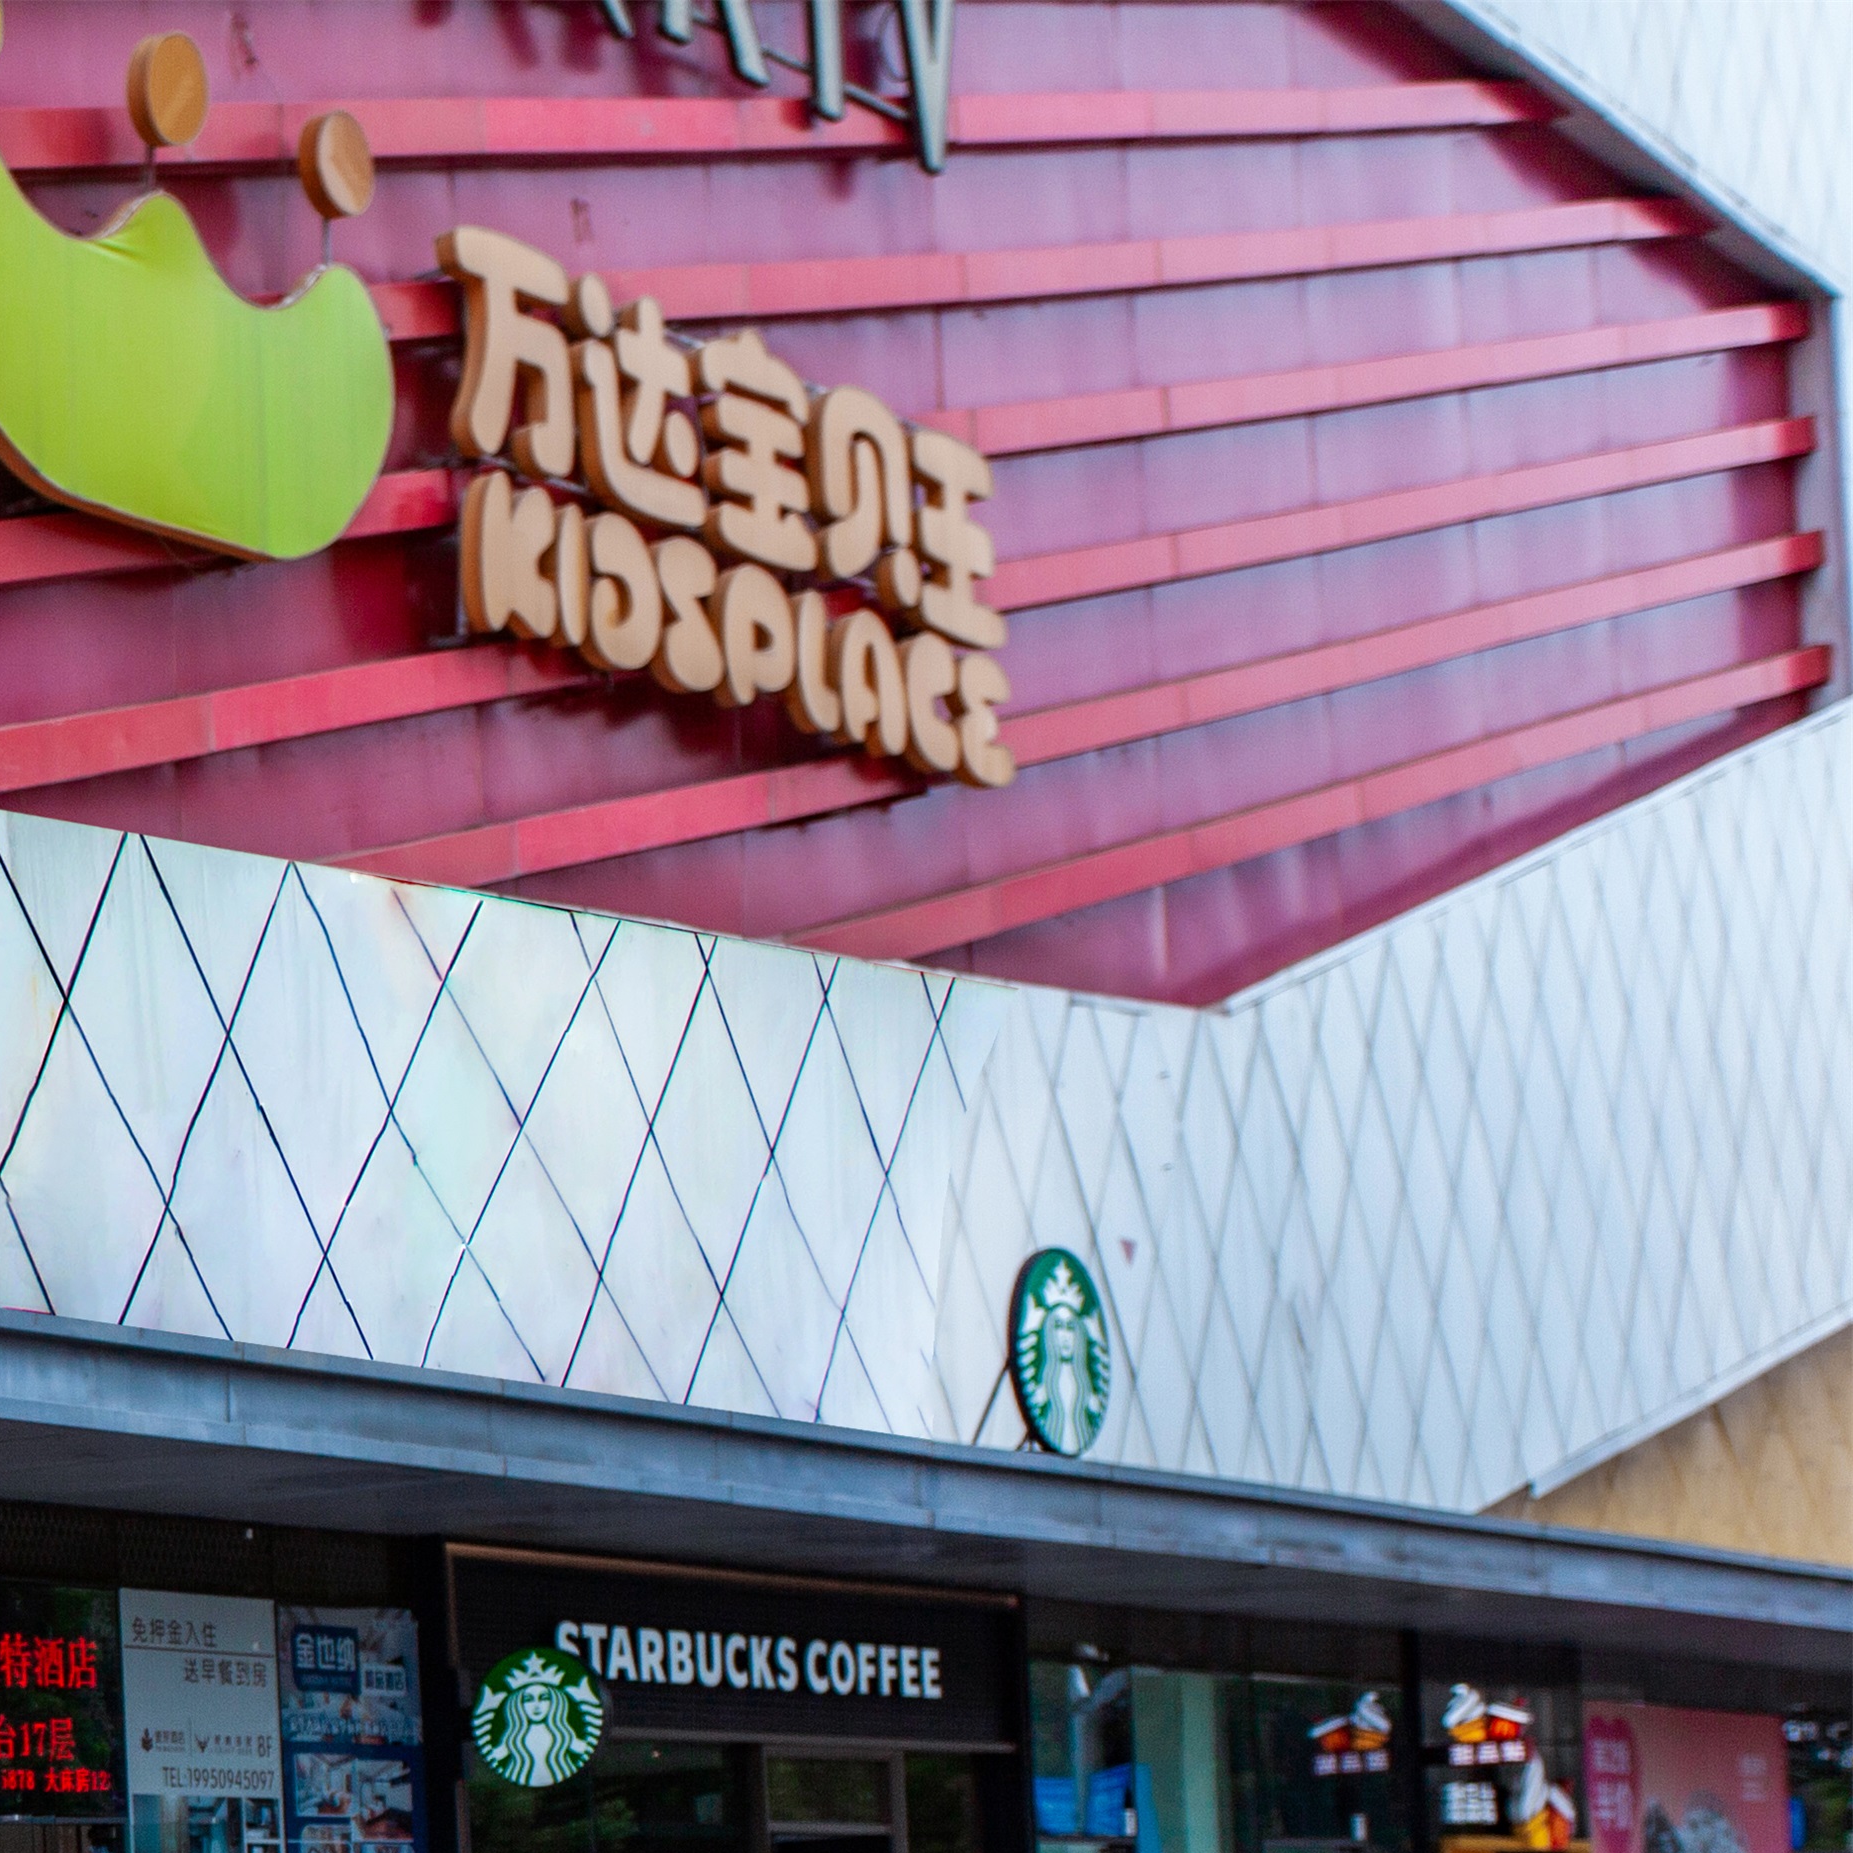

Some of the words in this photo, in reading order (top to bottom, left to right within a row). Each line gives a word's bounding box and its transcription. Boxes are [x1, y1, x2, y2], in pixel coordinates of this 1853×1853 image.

[436, 224, 1009, 650] 万达宝贝王
[132, 1616, 217, 1647] 免押金入住
[555, 1619, 797, 1692] STARBUCKS
[804, 1640, 942, 1699] COFFEE
